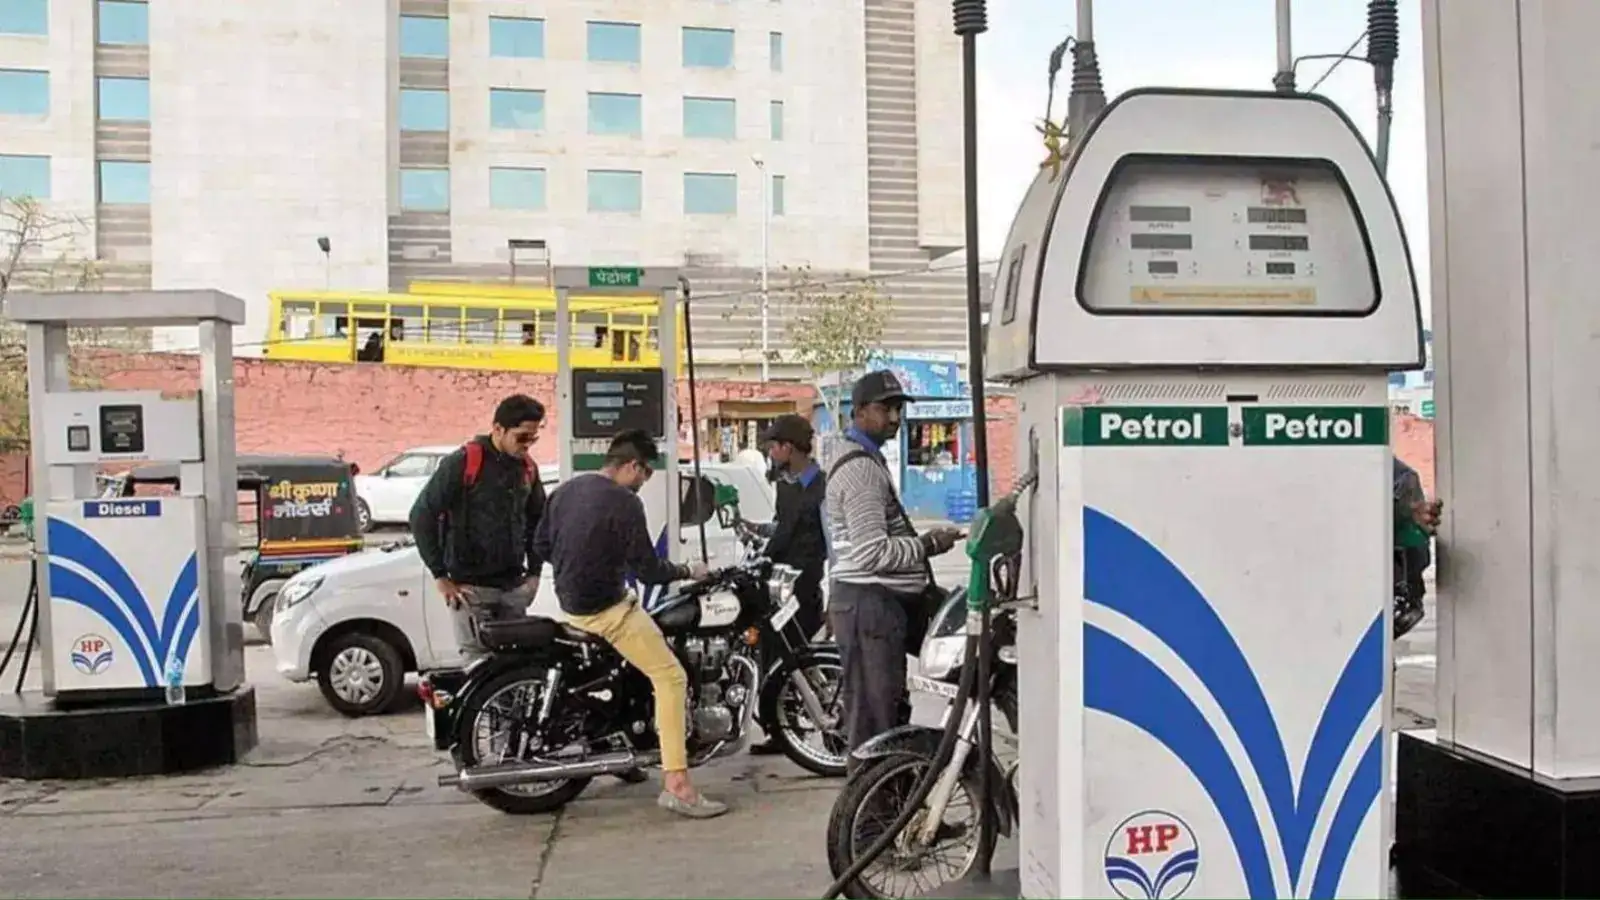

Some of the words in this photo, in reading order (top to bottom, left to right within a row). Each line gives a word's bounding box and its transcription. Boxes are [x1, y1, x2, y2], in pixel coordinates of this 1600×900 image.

[1101, 413, 1203, 439] Petrol
[1265, 413, 1363, 439] Petrol
[98, 503, 146, 515] Diesel
[81, 641, 104, 653] HP
[1126, 824, 1180, 855] HP
